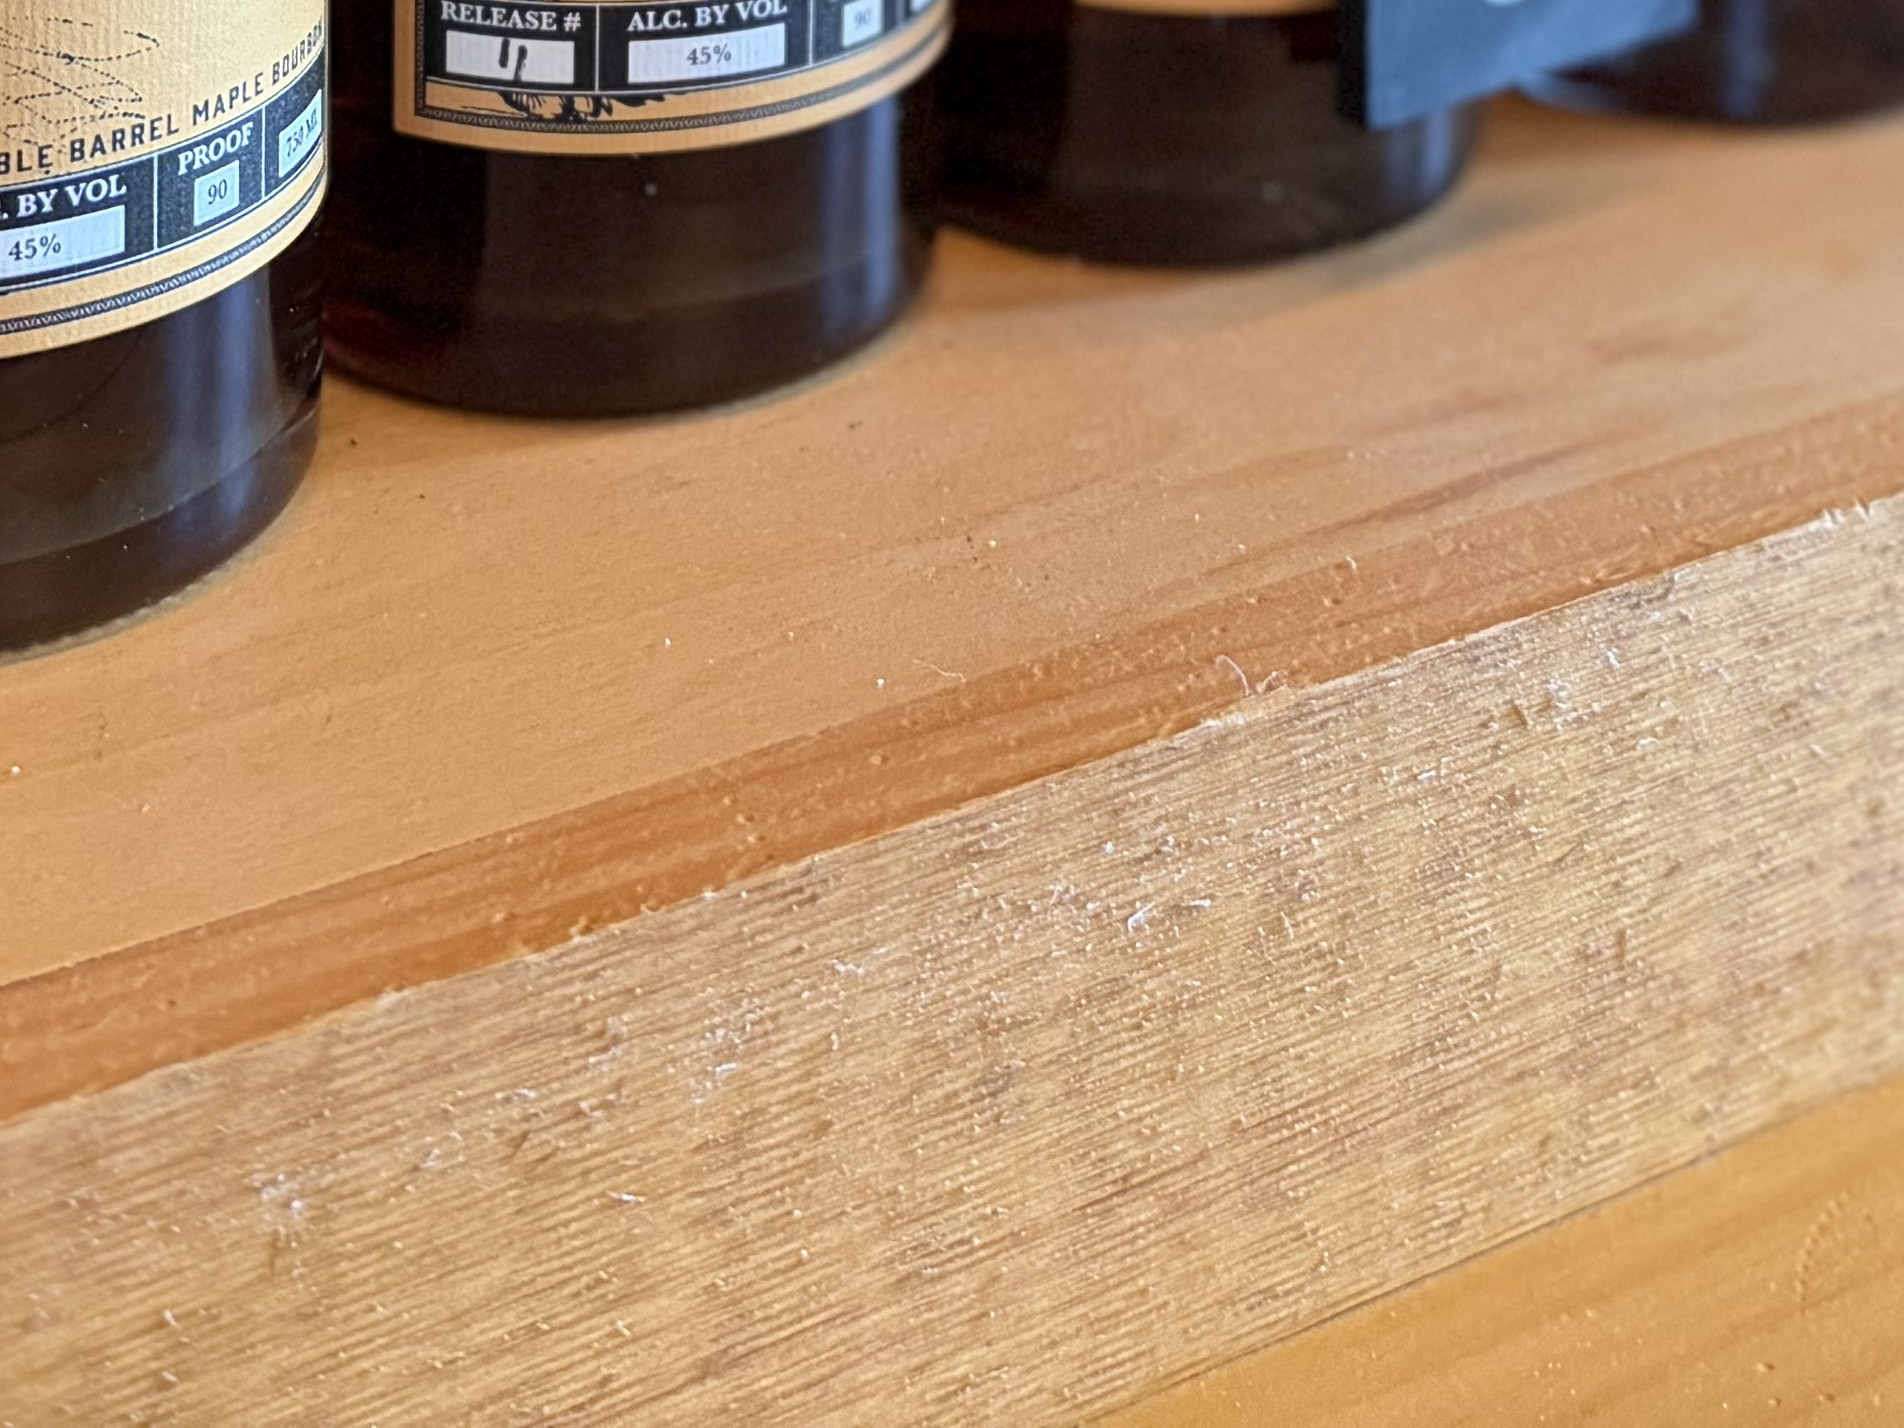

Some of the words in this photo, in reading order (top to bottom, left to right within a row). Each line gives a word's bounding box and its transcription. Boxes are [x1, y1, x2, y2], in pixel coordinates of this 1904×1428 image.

[441, 0, 557, 31] RELEASE
[563, 12, 581, 32] #
[627, 10, 687, 32] ALC.
[695, 4, 732, 27] BY
[854, 8, 872, 30] 90
[686, 43, 732, 66] 45%
[70, 112, 180, 163] BARREL
[192, 71, 265, 126] MAPLE
[177, 122, 254, 176] PROOF
[17, 190, 60, 218] BY
[66, 173, 127, 204] VOL
[207, 178, 228, 205] 90
[8, 233, 61, 261] 45%
